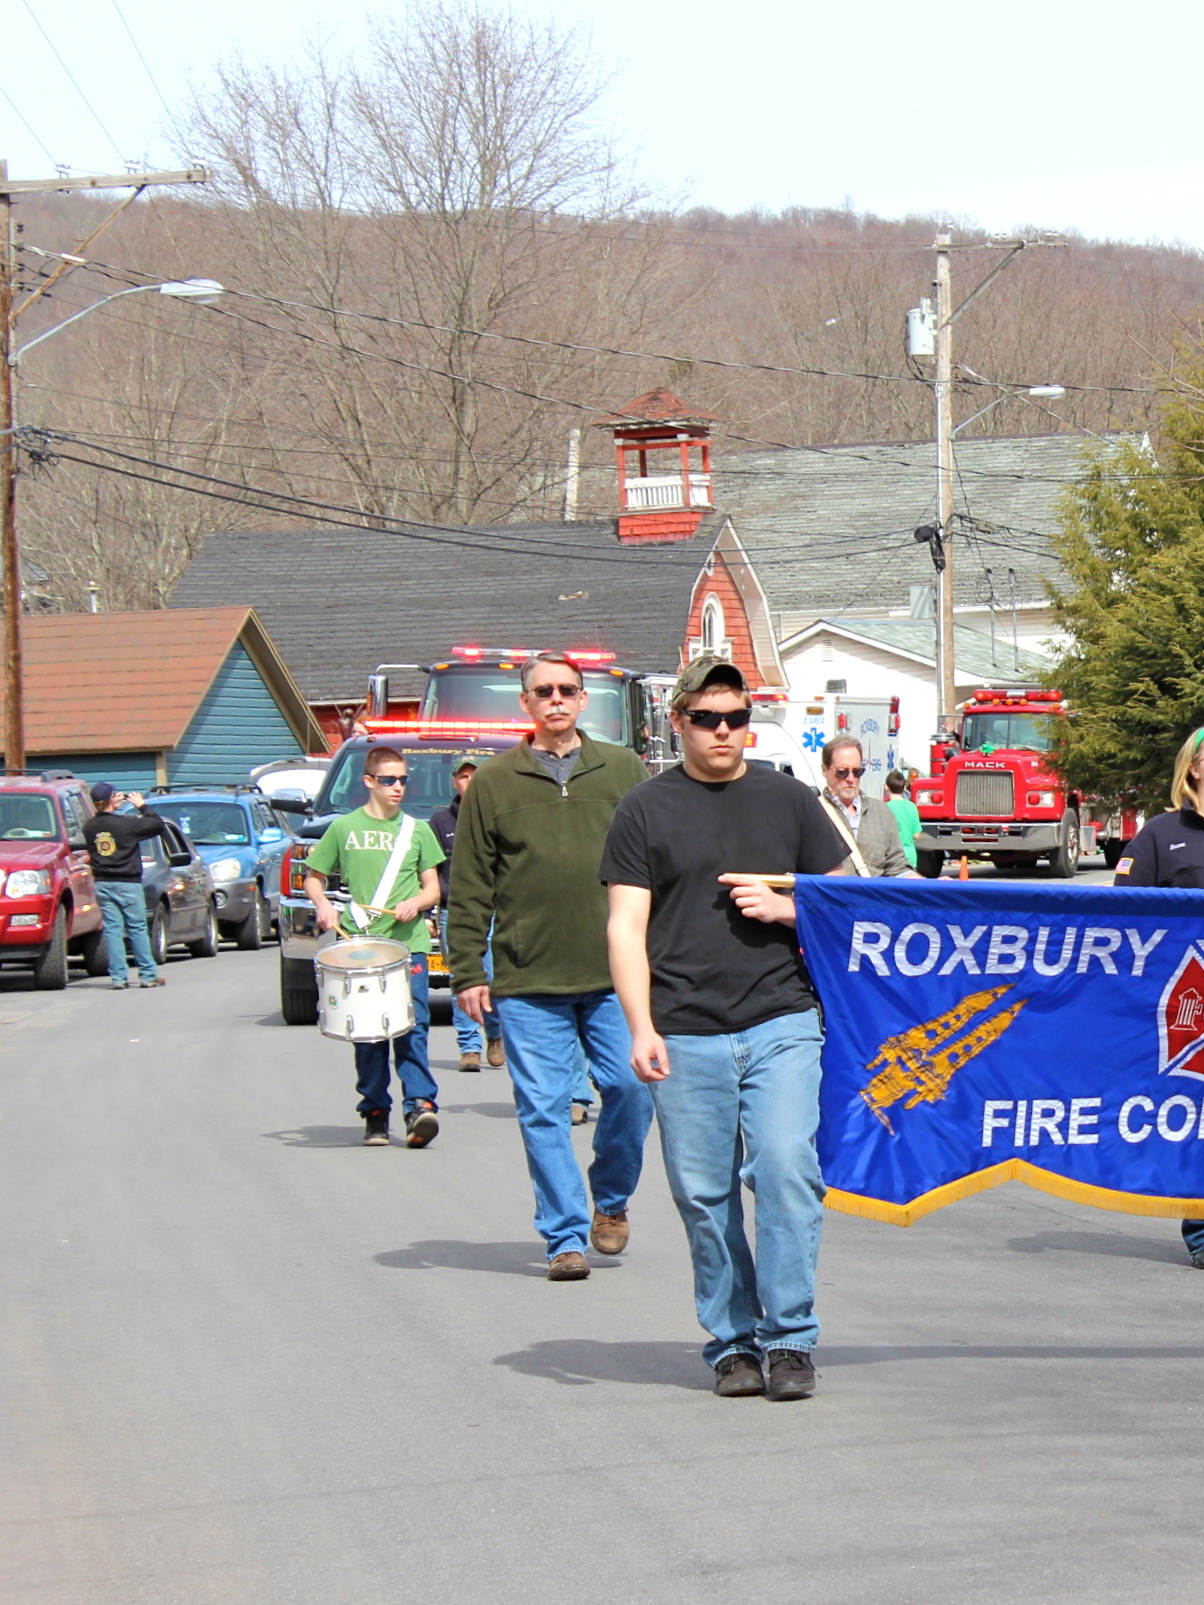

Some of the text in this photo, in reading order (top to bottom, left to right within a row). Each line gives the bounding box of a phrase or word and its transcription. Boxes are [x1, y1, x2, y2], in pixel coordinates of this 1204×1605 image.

[402, 748, 463, 756] Roxbury
[344, 830, 411, 851] AER
[847, 920, 1169, 977] ROXBURY
[981, 1097, 1102, 1148] FIRE
